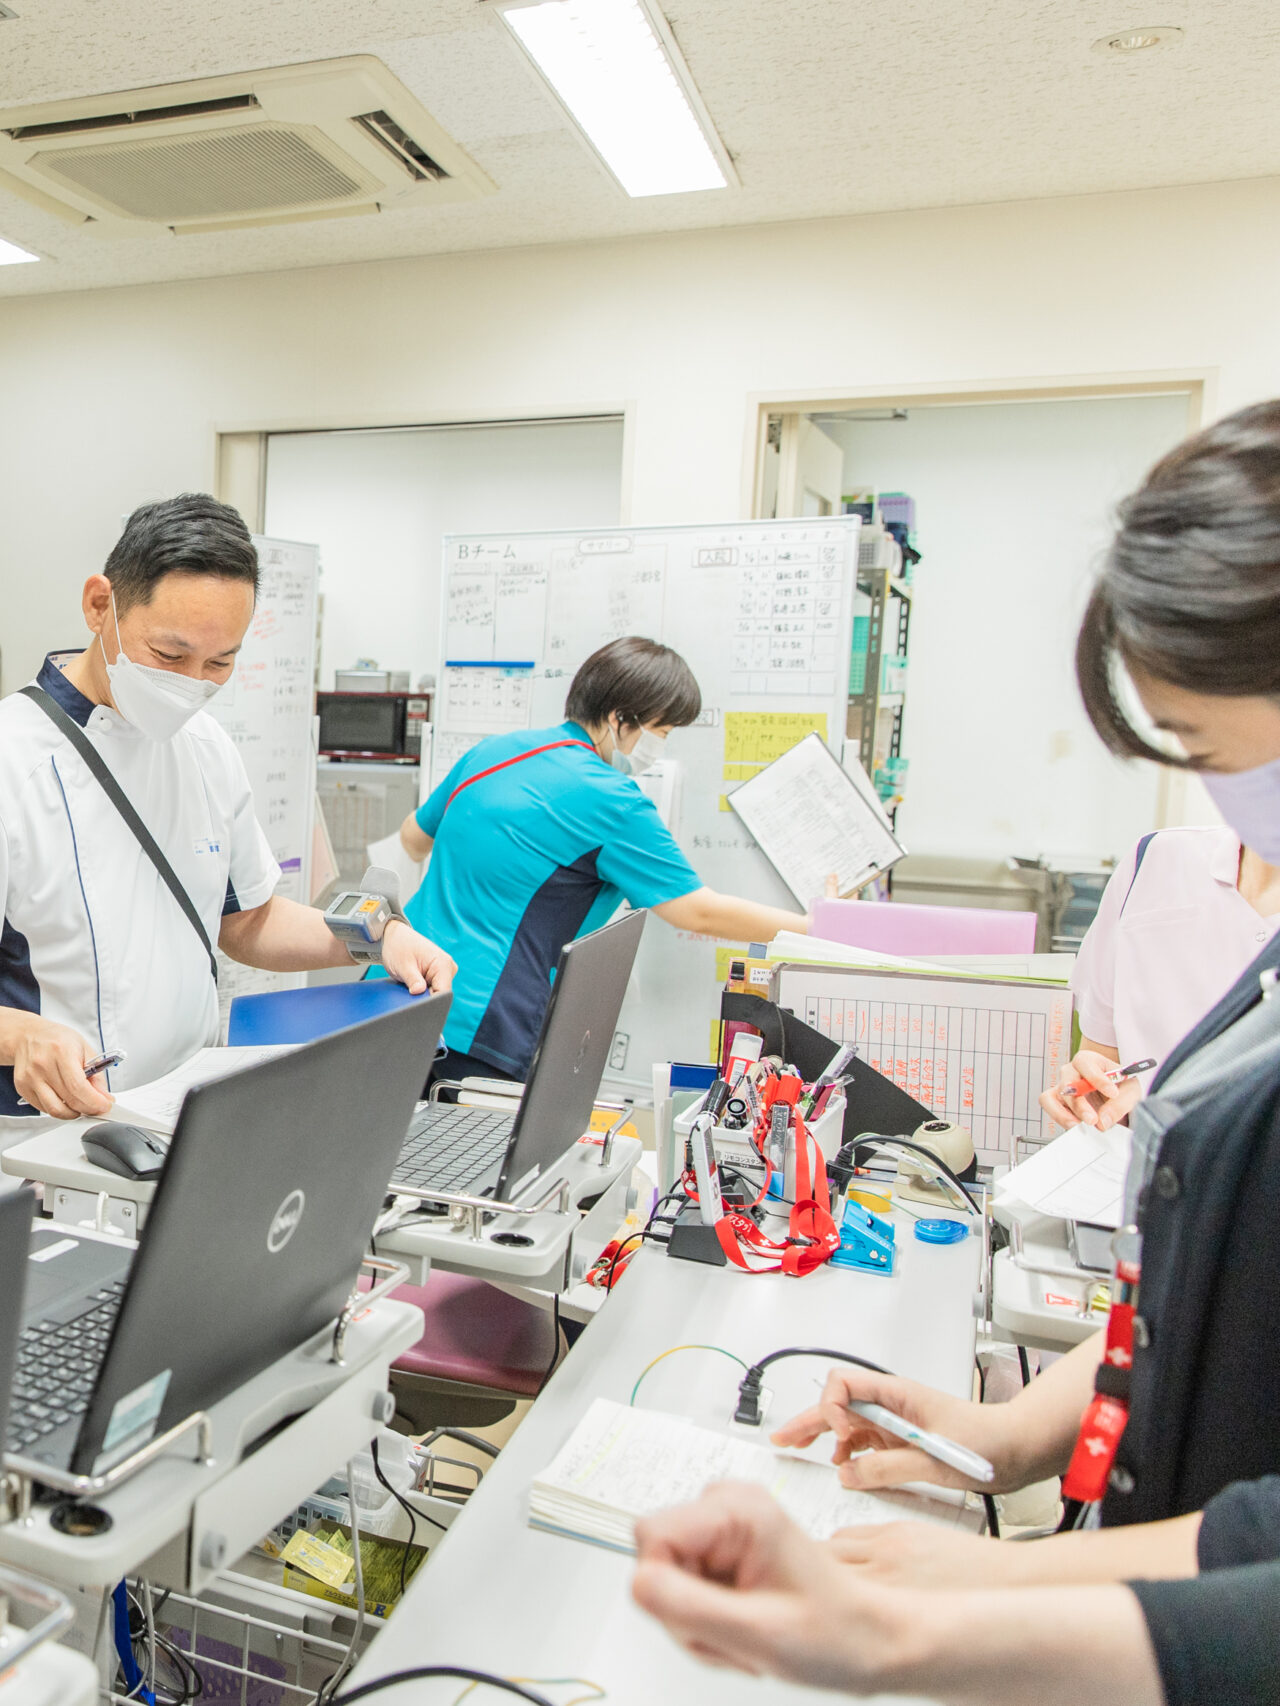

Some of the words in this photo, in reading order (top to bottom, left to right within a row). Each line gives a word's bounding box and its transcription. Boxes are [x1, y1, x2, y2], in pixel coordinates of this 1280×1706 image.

[458, 544, 516, 559] Bチーム
[724, 1153, 762, 1165] リモコンスタン
